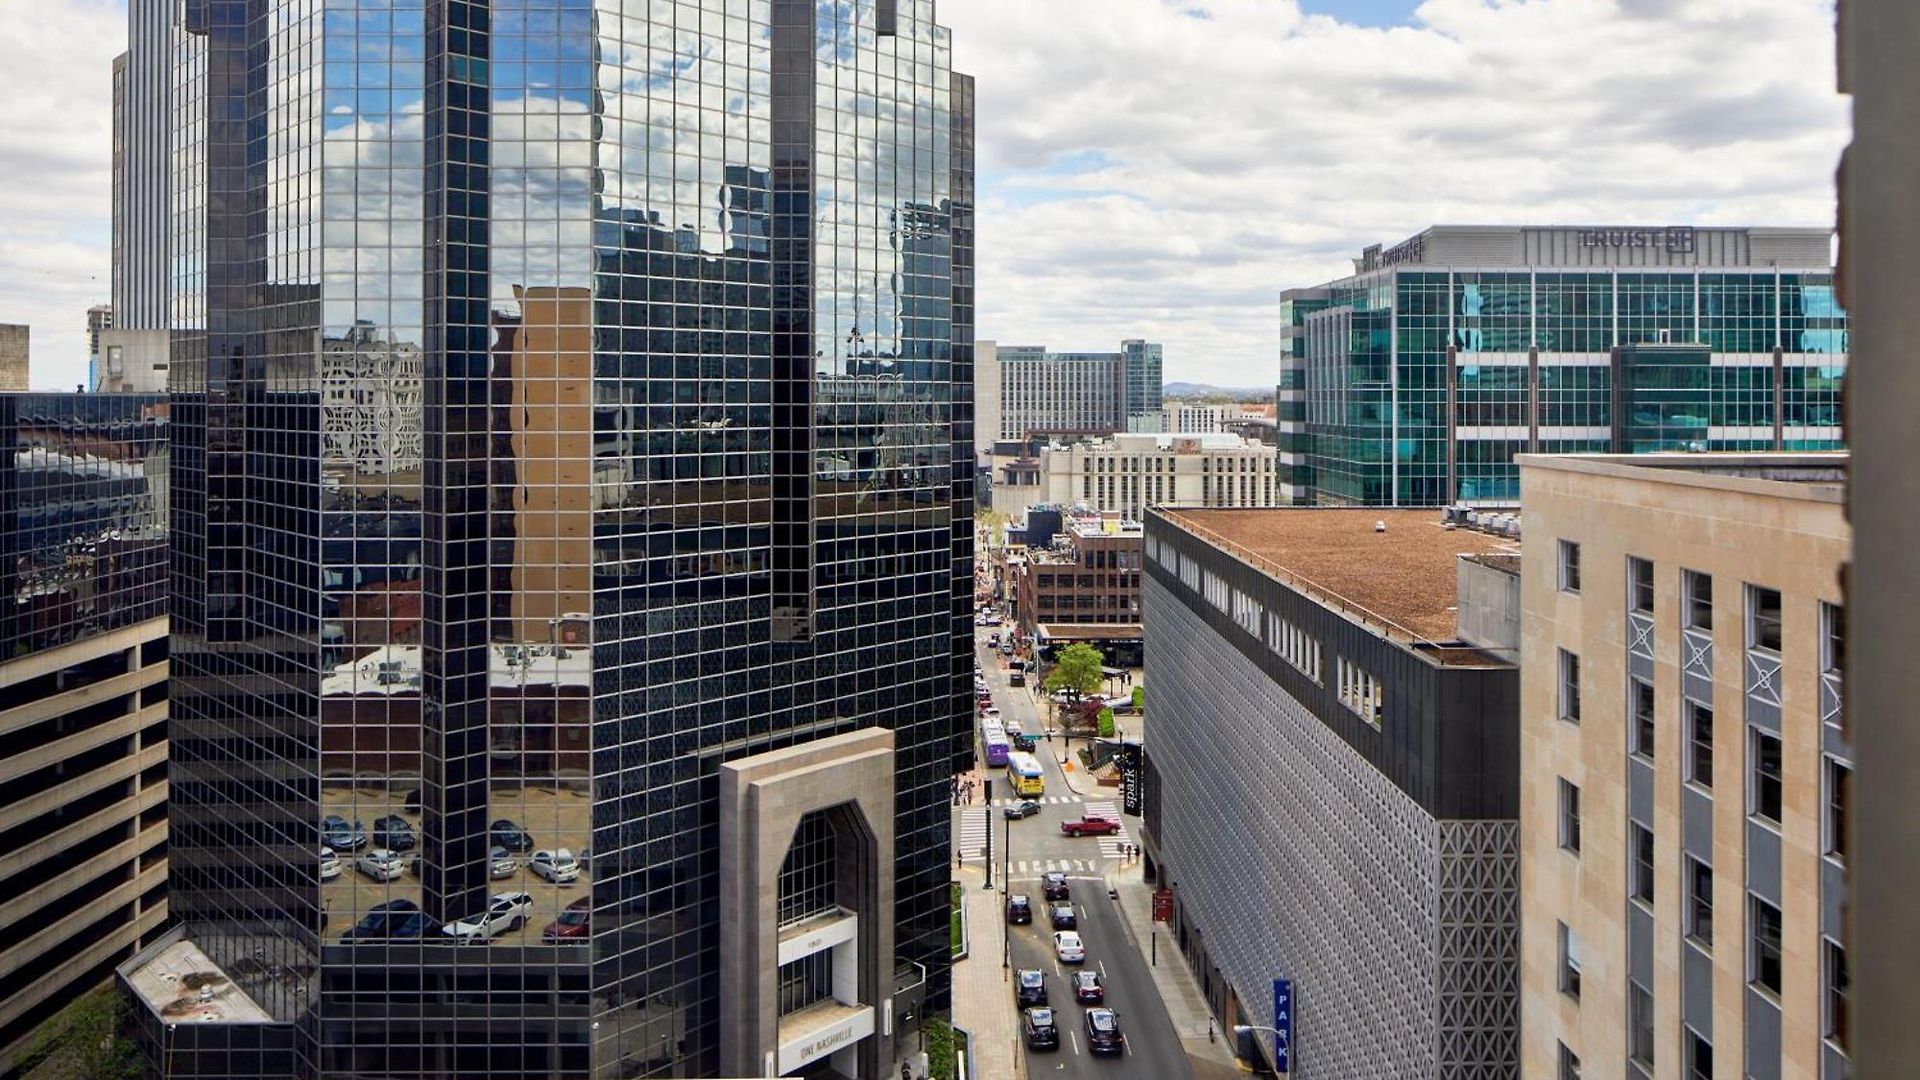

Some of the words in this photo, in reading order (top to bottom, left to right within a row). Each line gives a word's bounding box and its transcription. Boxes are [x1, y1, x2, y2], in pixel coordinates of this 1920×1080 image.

[1579, 230, 1661, 248] TRUIST
[1125, 768, 1138, 809] spark
[1278, 995, 1289, 1057] PARK
